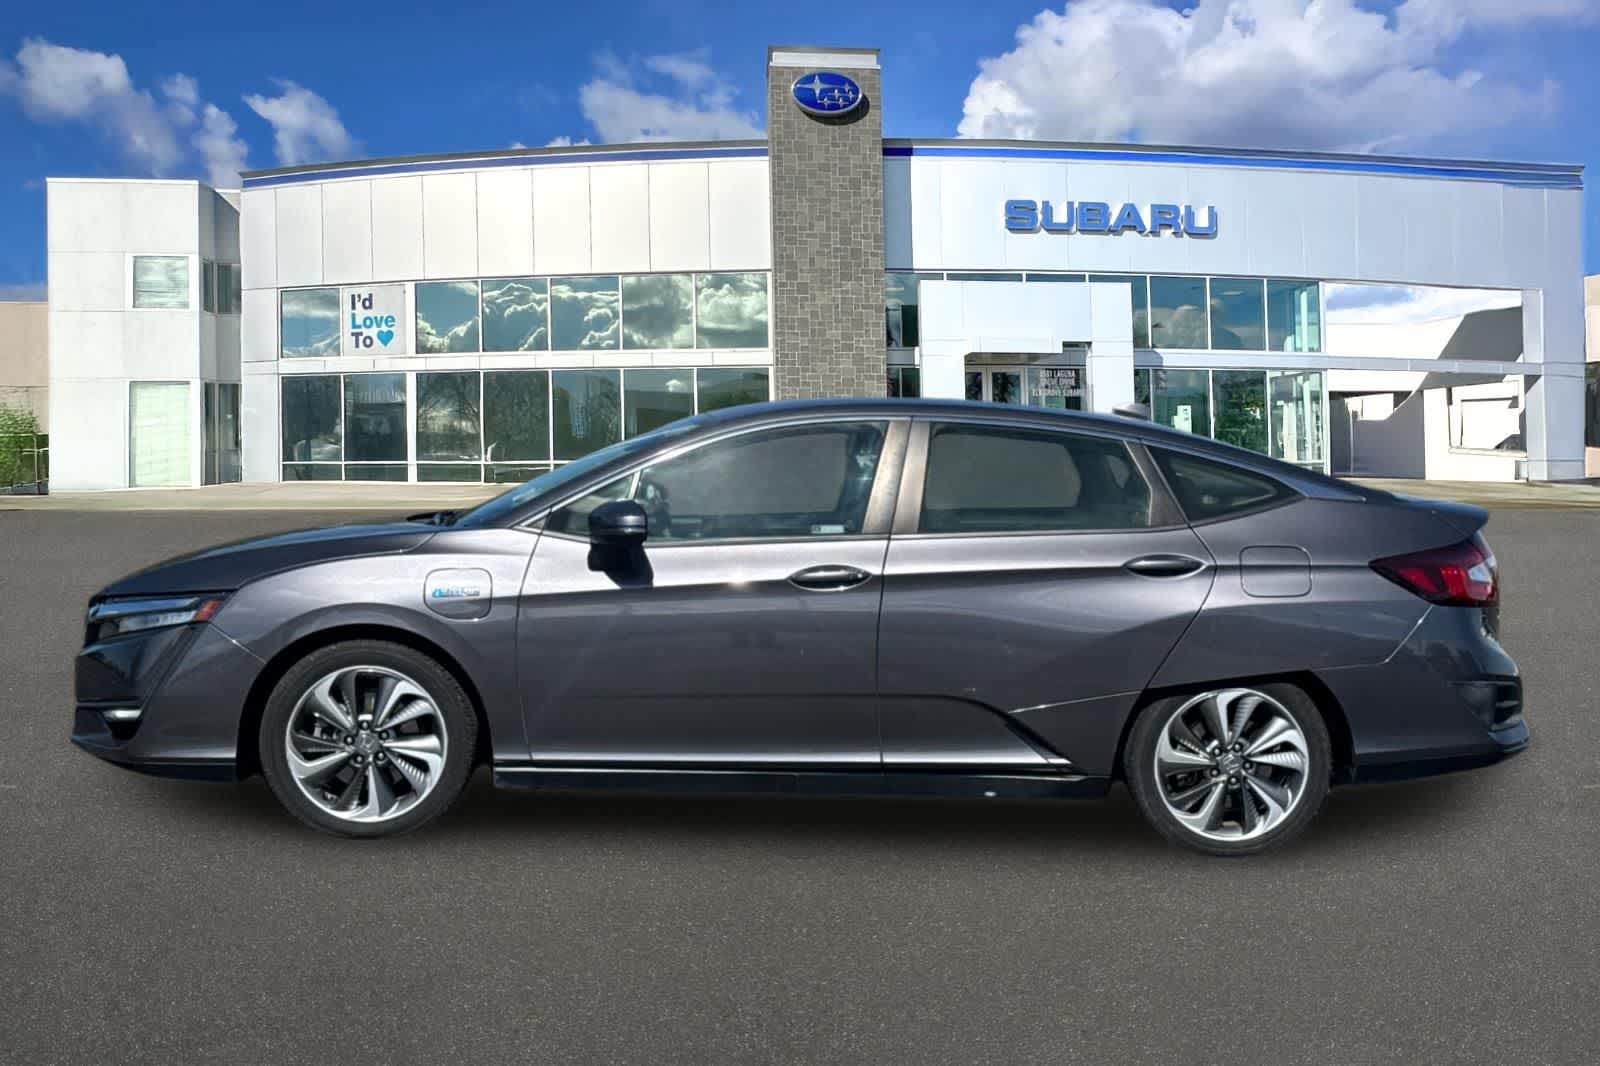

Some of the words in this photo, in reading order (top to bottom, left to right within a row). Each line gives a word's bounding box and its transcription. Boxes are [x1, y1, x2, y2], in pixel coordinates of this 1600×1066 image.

[1005, 200, 1218, 239] SUBARU
[351, 312, 396, 329] Love
[351, 332, 374, 348] To
